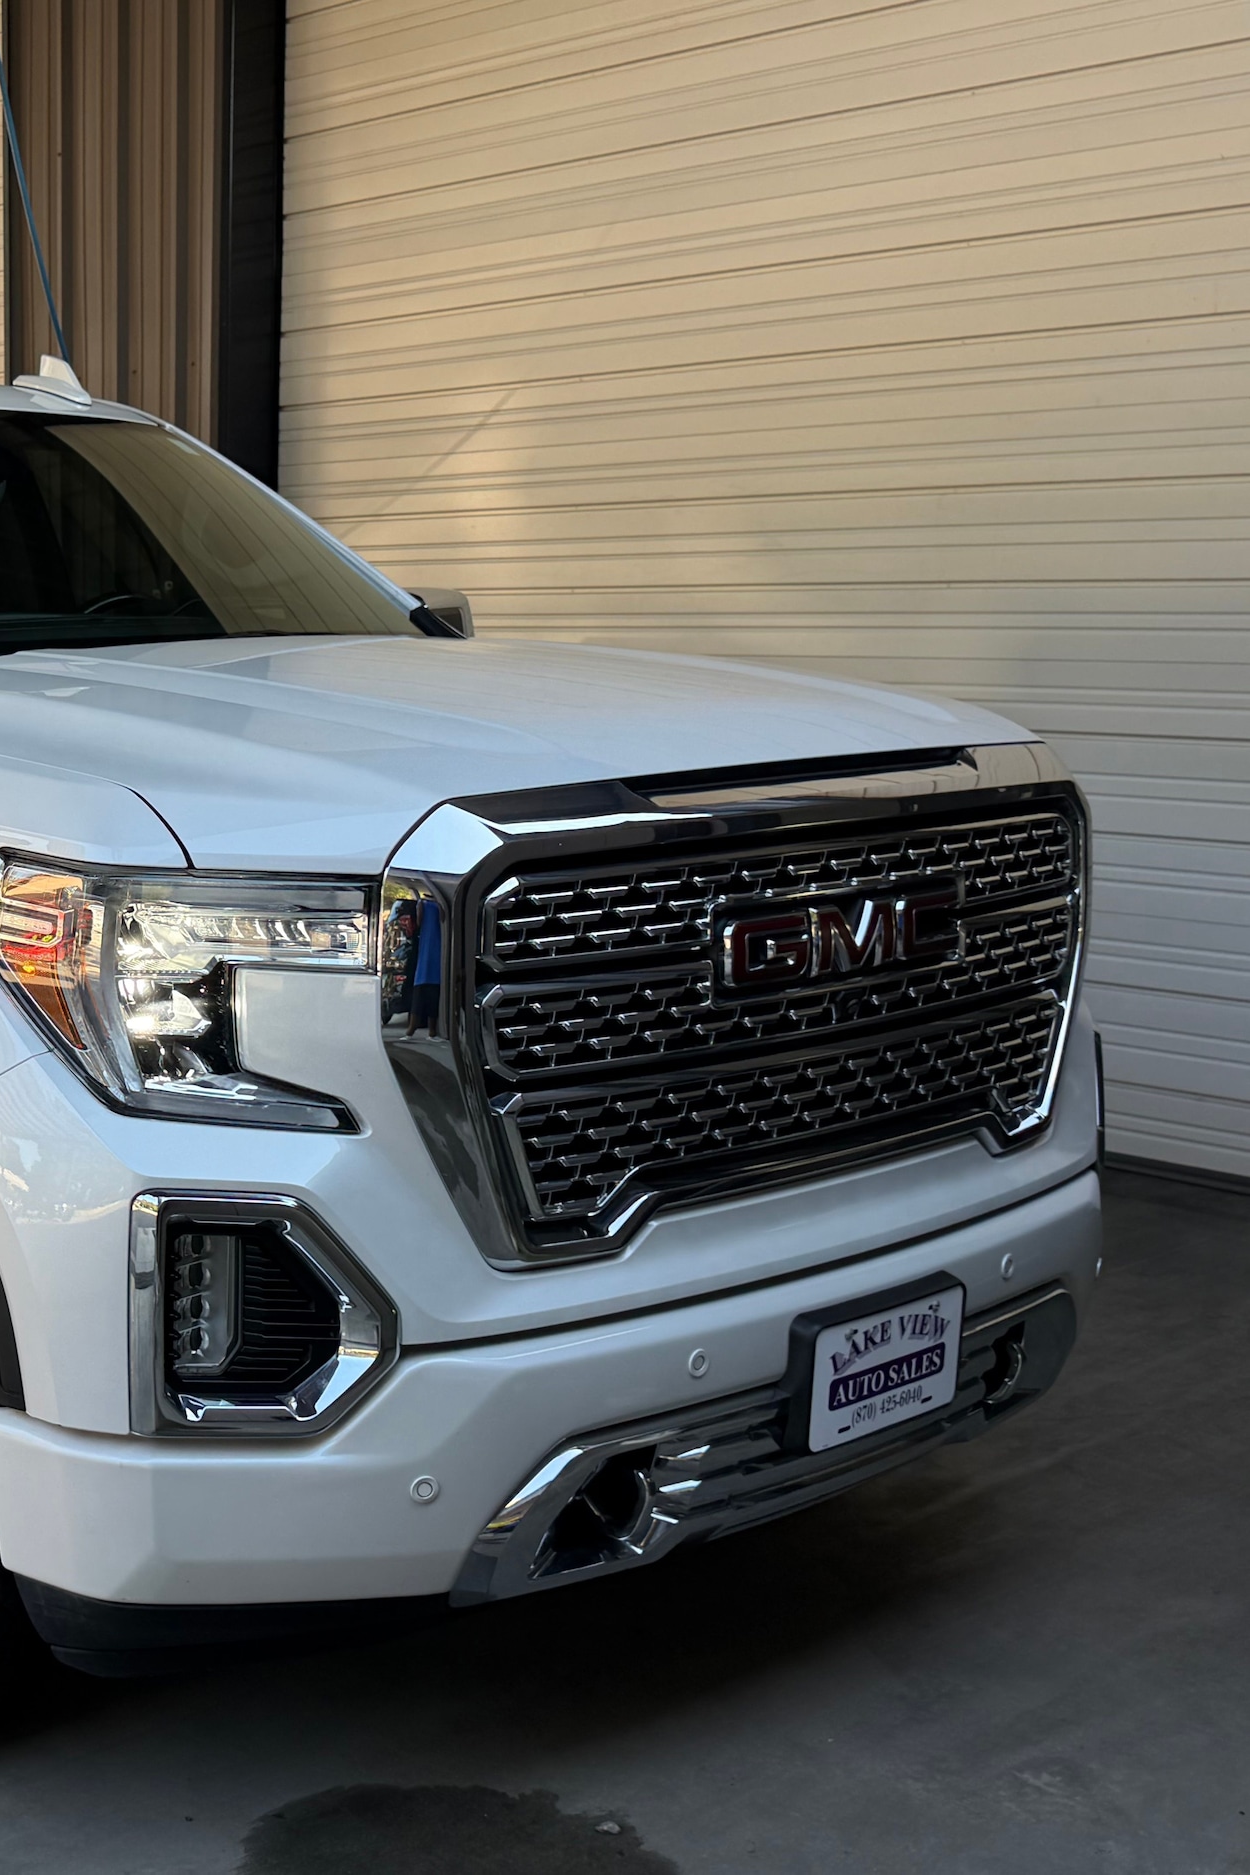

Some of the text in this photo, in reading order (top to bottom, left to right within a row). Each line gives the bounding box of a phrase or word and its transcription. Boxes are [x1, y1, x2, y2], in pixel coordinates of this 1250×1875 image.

[722, 889, 961, 987] GMC
[829, 1313, 951, 1376] LAKE VIEW
[833, 1349, 941, 1406] AUTO SALES
[851, 1384, 923, 1428] (870) 425-6040
